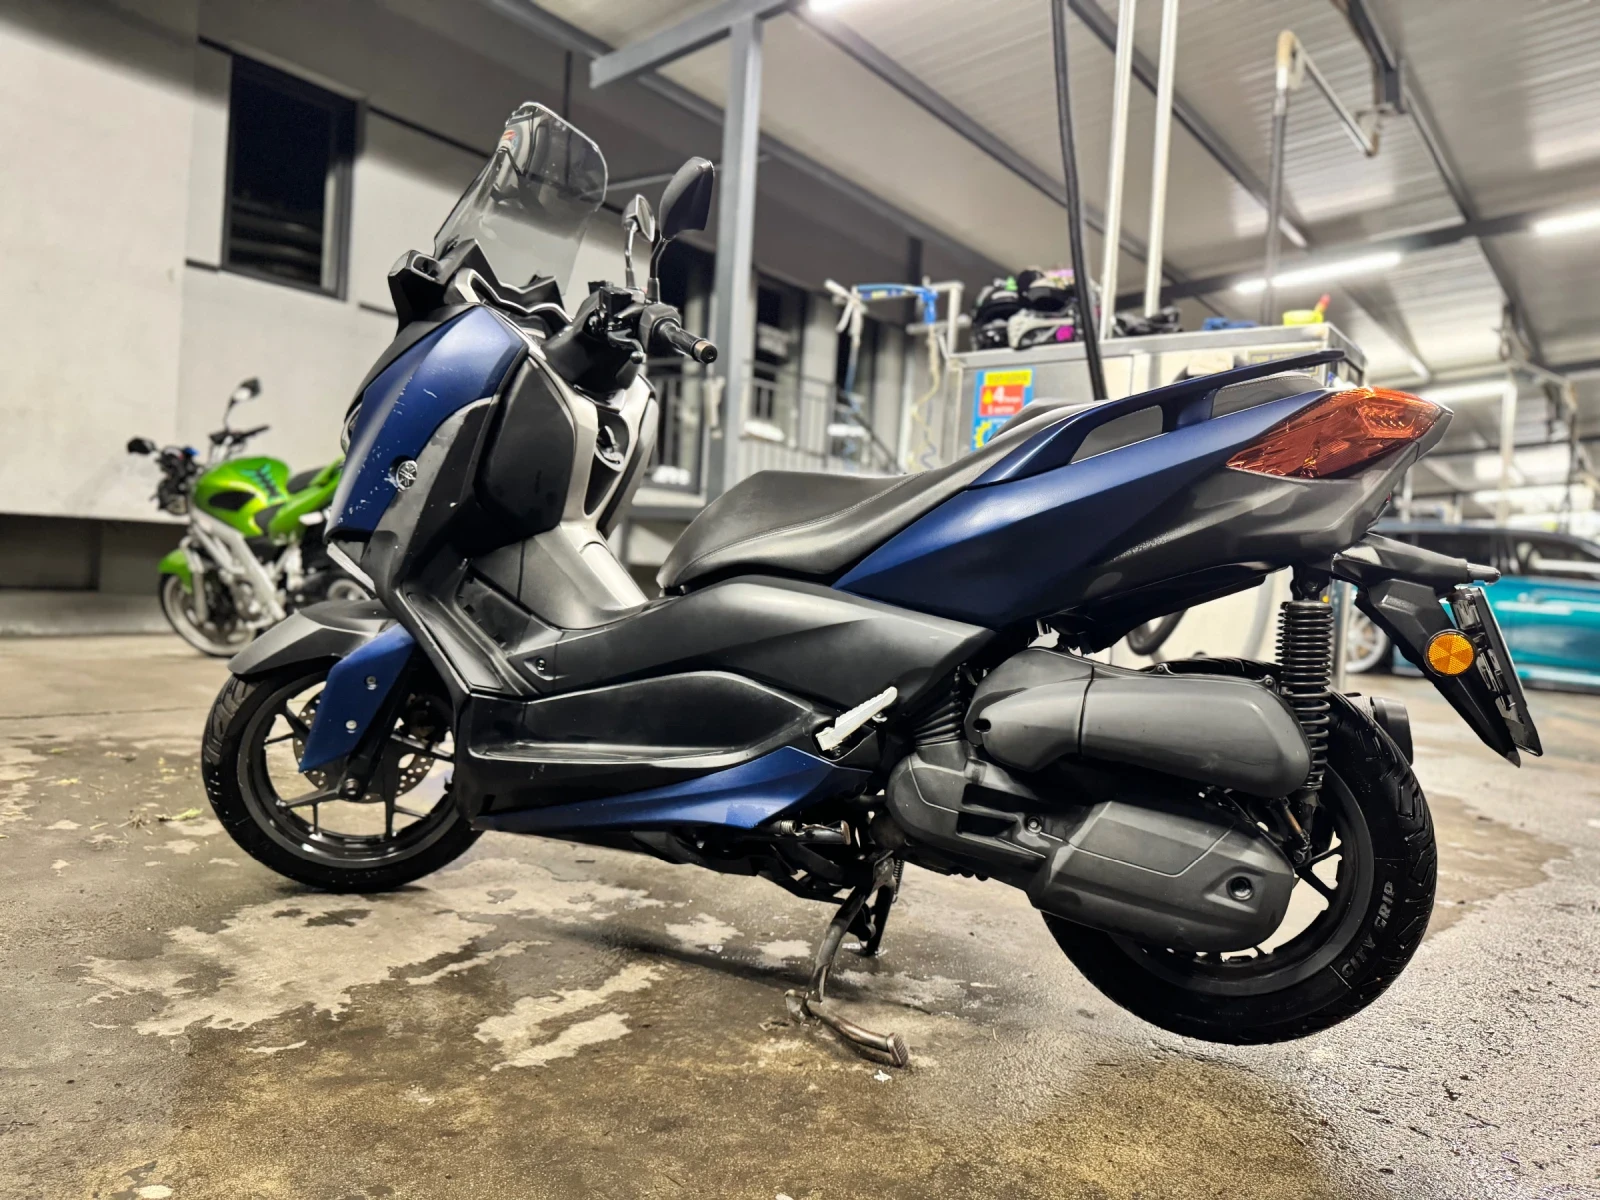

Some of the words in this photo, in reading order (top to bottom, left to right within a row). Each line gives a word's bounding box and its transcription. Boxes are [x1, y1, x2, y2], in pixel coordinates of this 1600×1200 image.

[993, 386, 1005, 404] 4
[1341, 933, 1376, 978] CITY
[1374, 881, 1395, 930] GRIP
